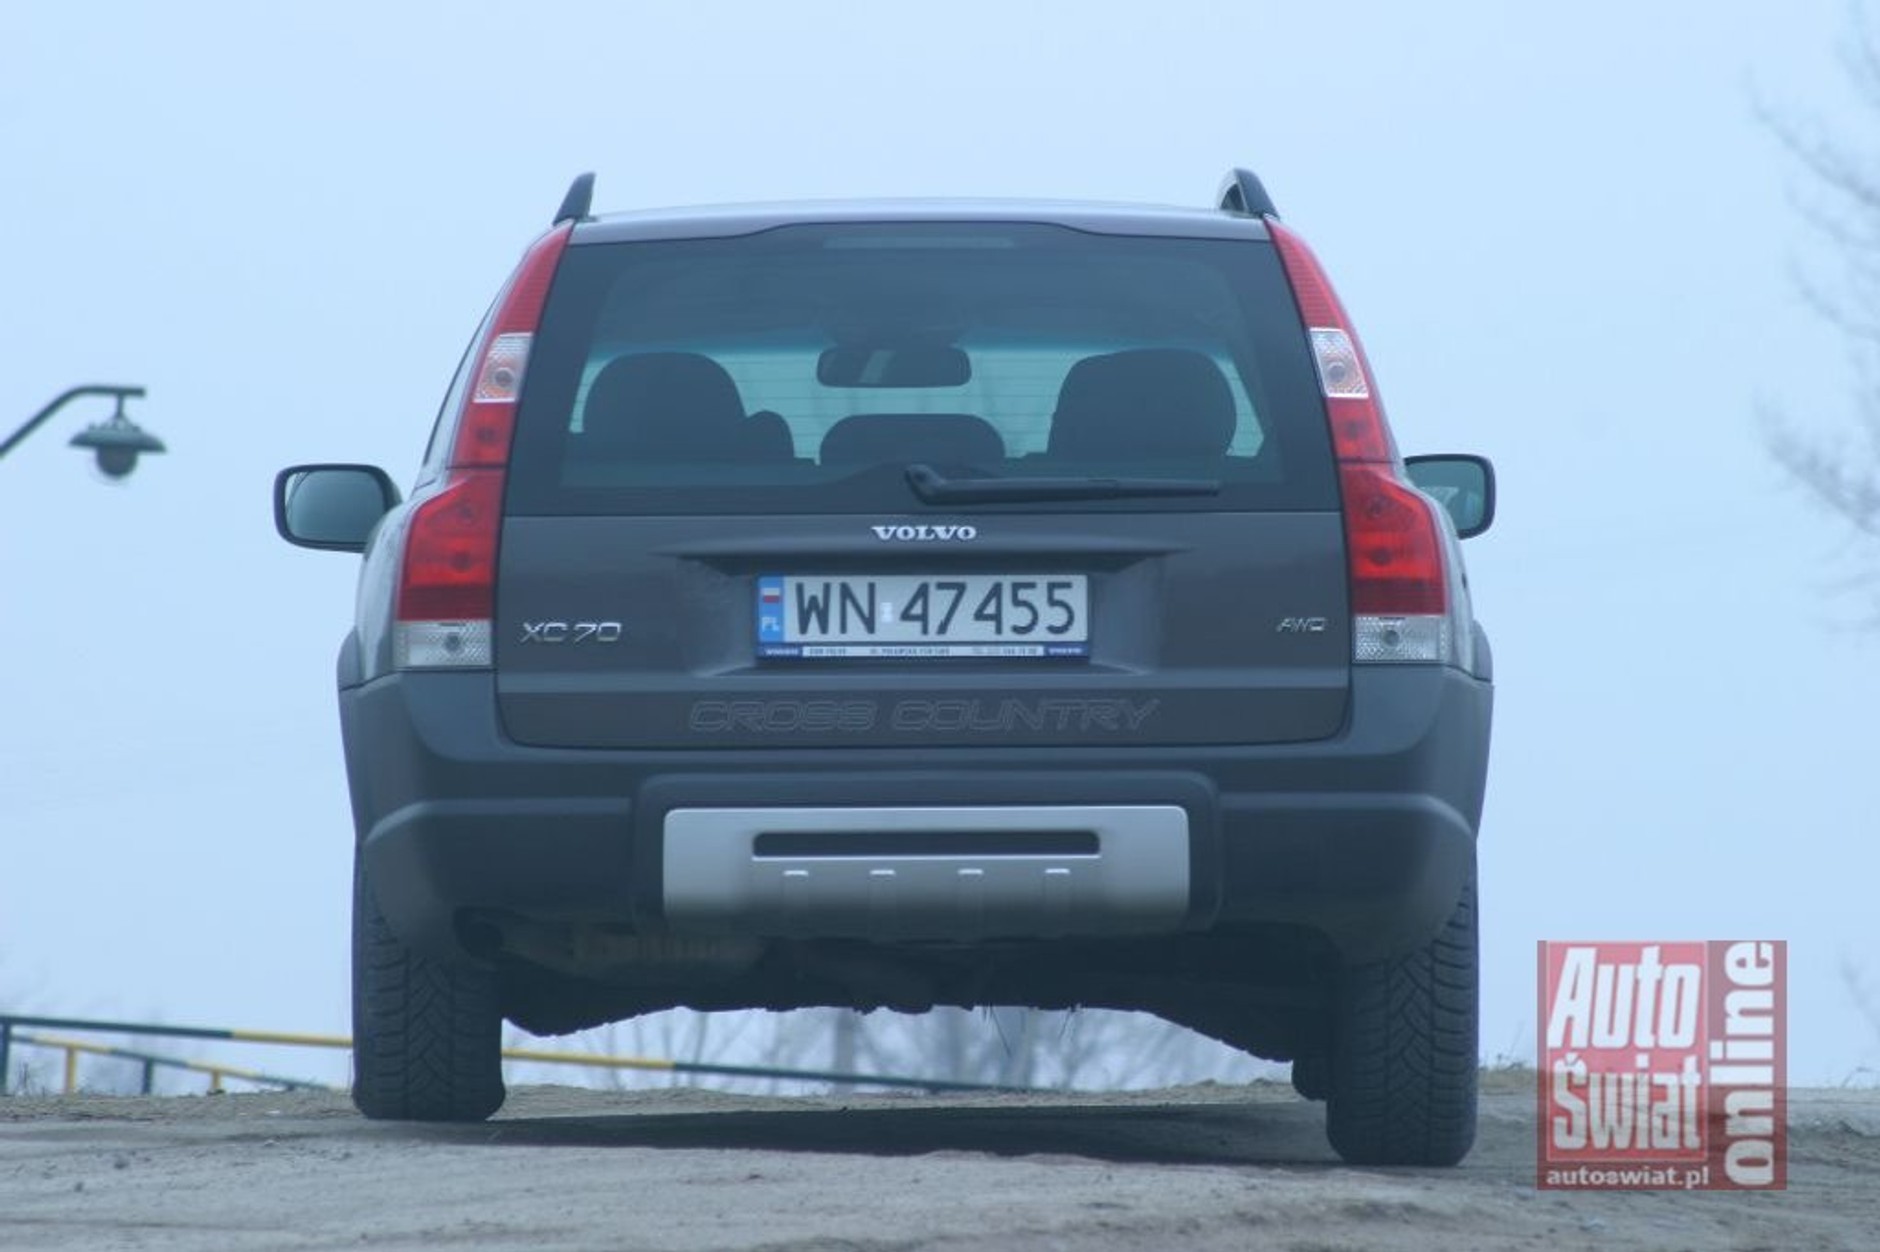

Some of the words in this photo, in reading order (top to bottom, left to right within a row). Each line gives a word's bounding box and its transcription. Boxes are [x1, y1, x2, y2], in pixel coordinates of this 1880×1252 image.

[872, 525, 977, 541] VOLVO
[795, 581, 876, 636] WN
[900, 581, 1076, 636] 47455
[521, 621, 568, 642] XC
[573, 621, 622, 643] 70
[761, 616, 780, 633] PL
[1276, 616, 1326, 633] AWD
[689, 699, 876, 732] CROSS
[892, 698, 1160, 732] COUNTRY
